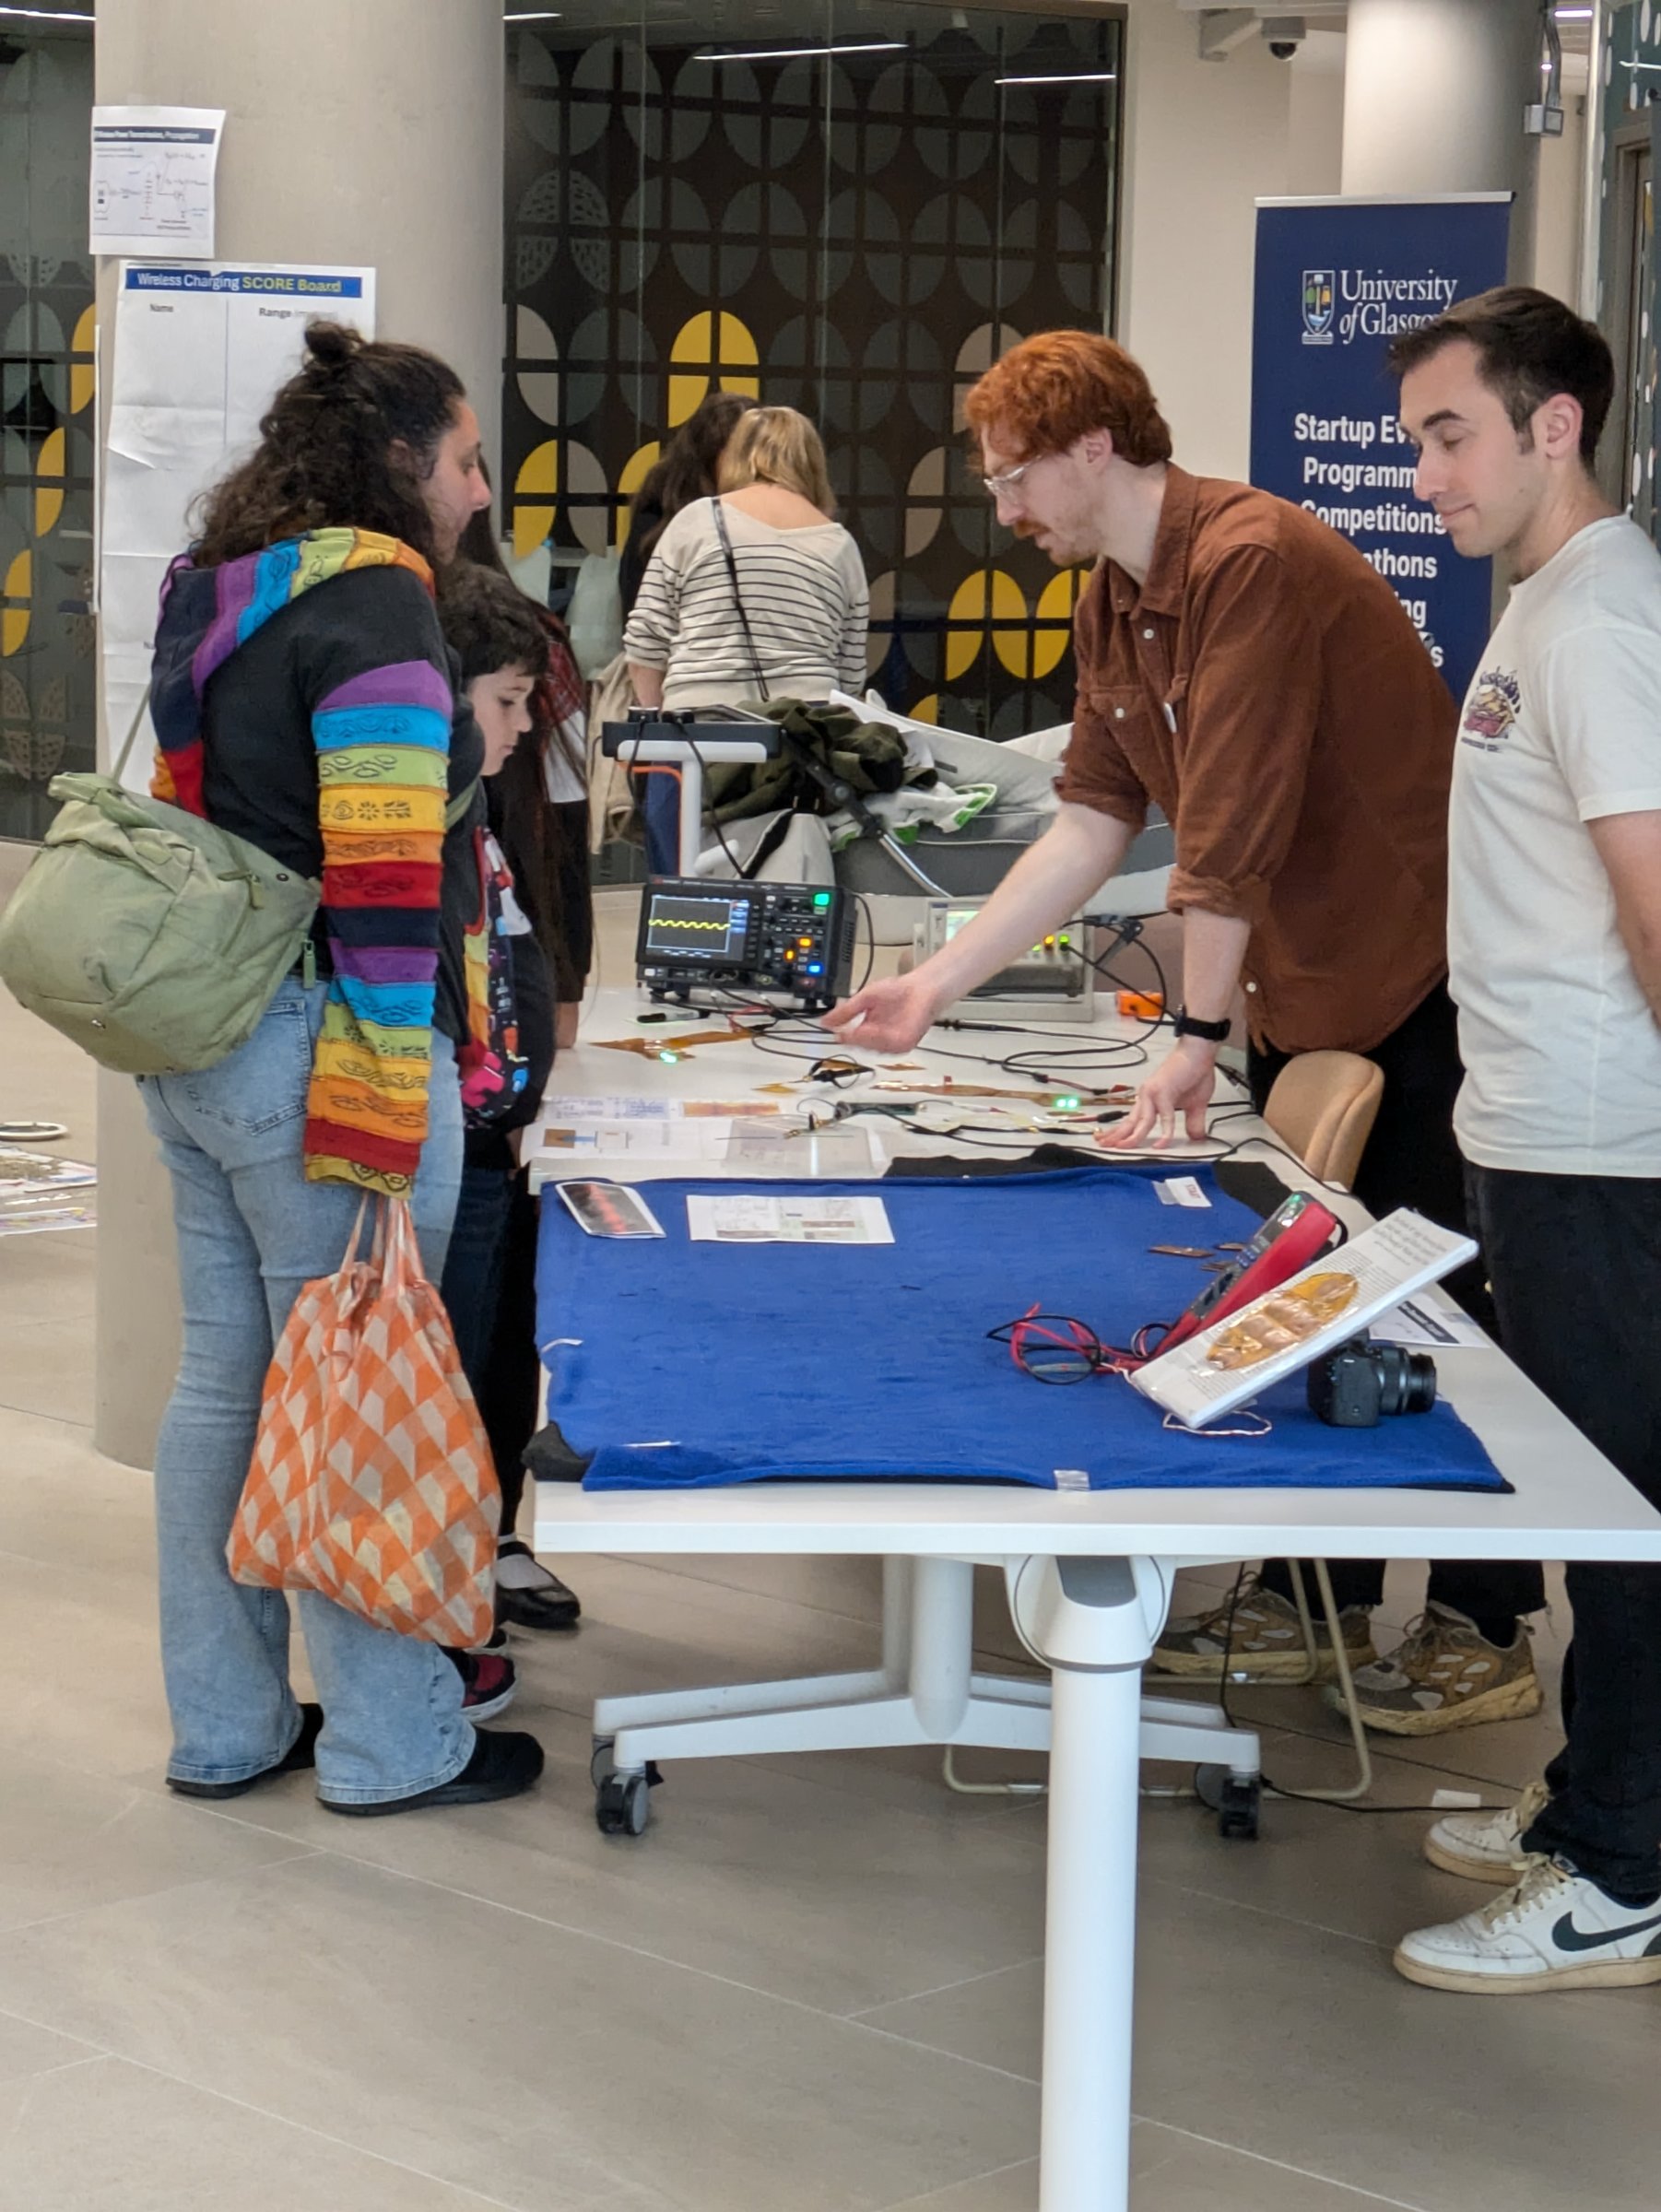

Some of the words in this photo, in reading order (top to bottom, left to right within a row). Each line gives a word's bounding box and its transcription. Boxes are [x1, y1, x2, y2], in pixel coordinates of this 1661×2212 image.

[137, 272, 182, 287] Wireless
[183, 274, 240, 290] Charging
[242, 276, 294, 291] SCORE
[297, 277, 342, 293] Board
[1340, 269, 1458, 311] University
[149, 303, 174, 313] Name
[259, 307, 292, 319] Range
[1339, 301, 1363, 345] of
[1294, 413, 1376, 450] Startup
[1303, 456, 1418, 493] Programm
